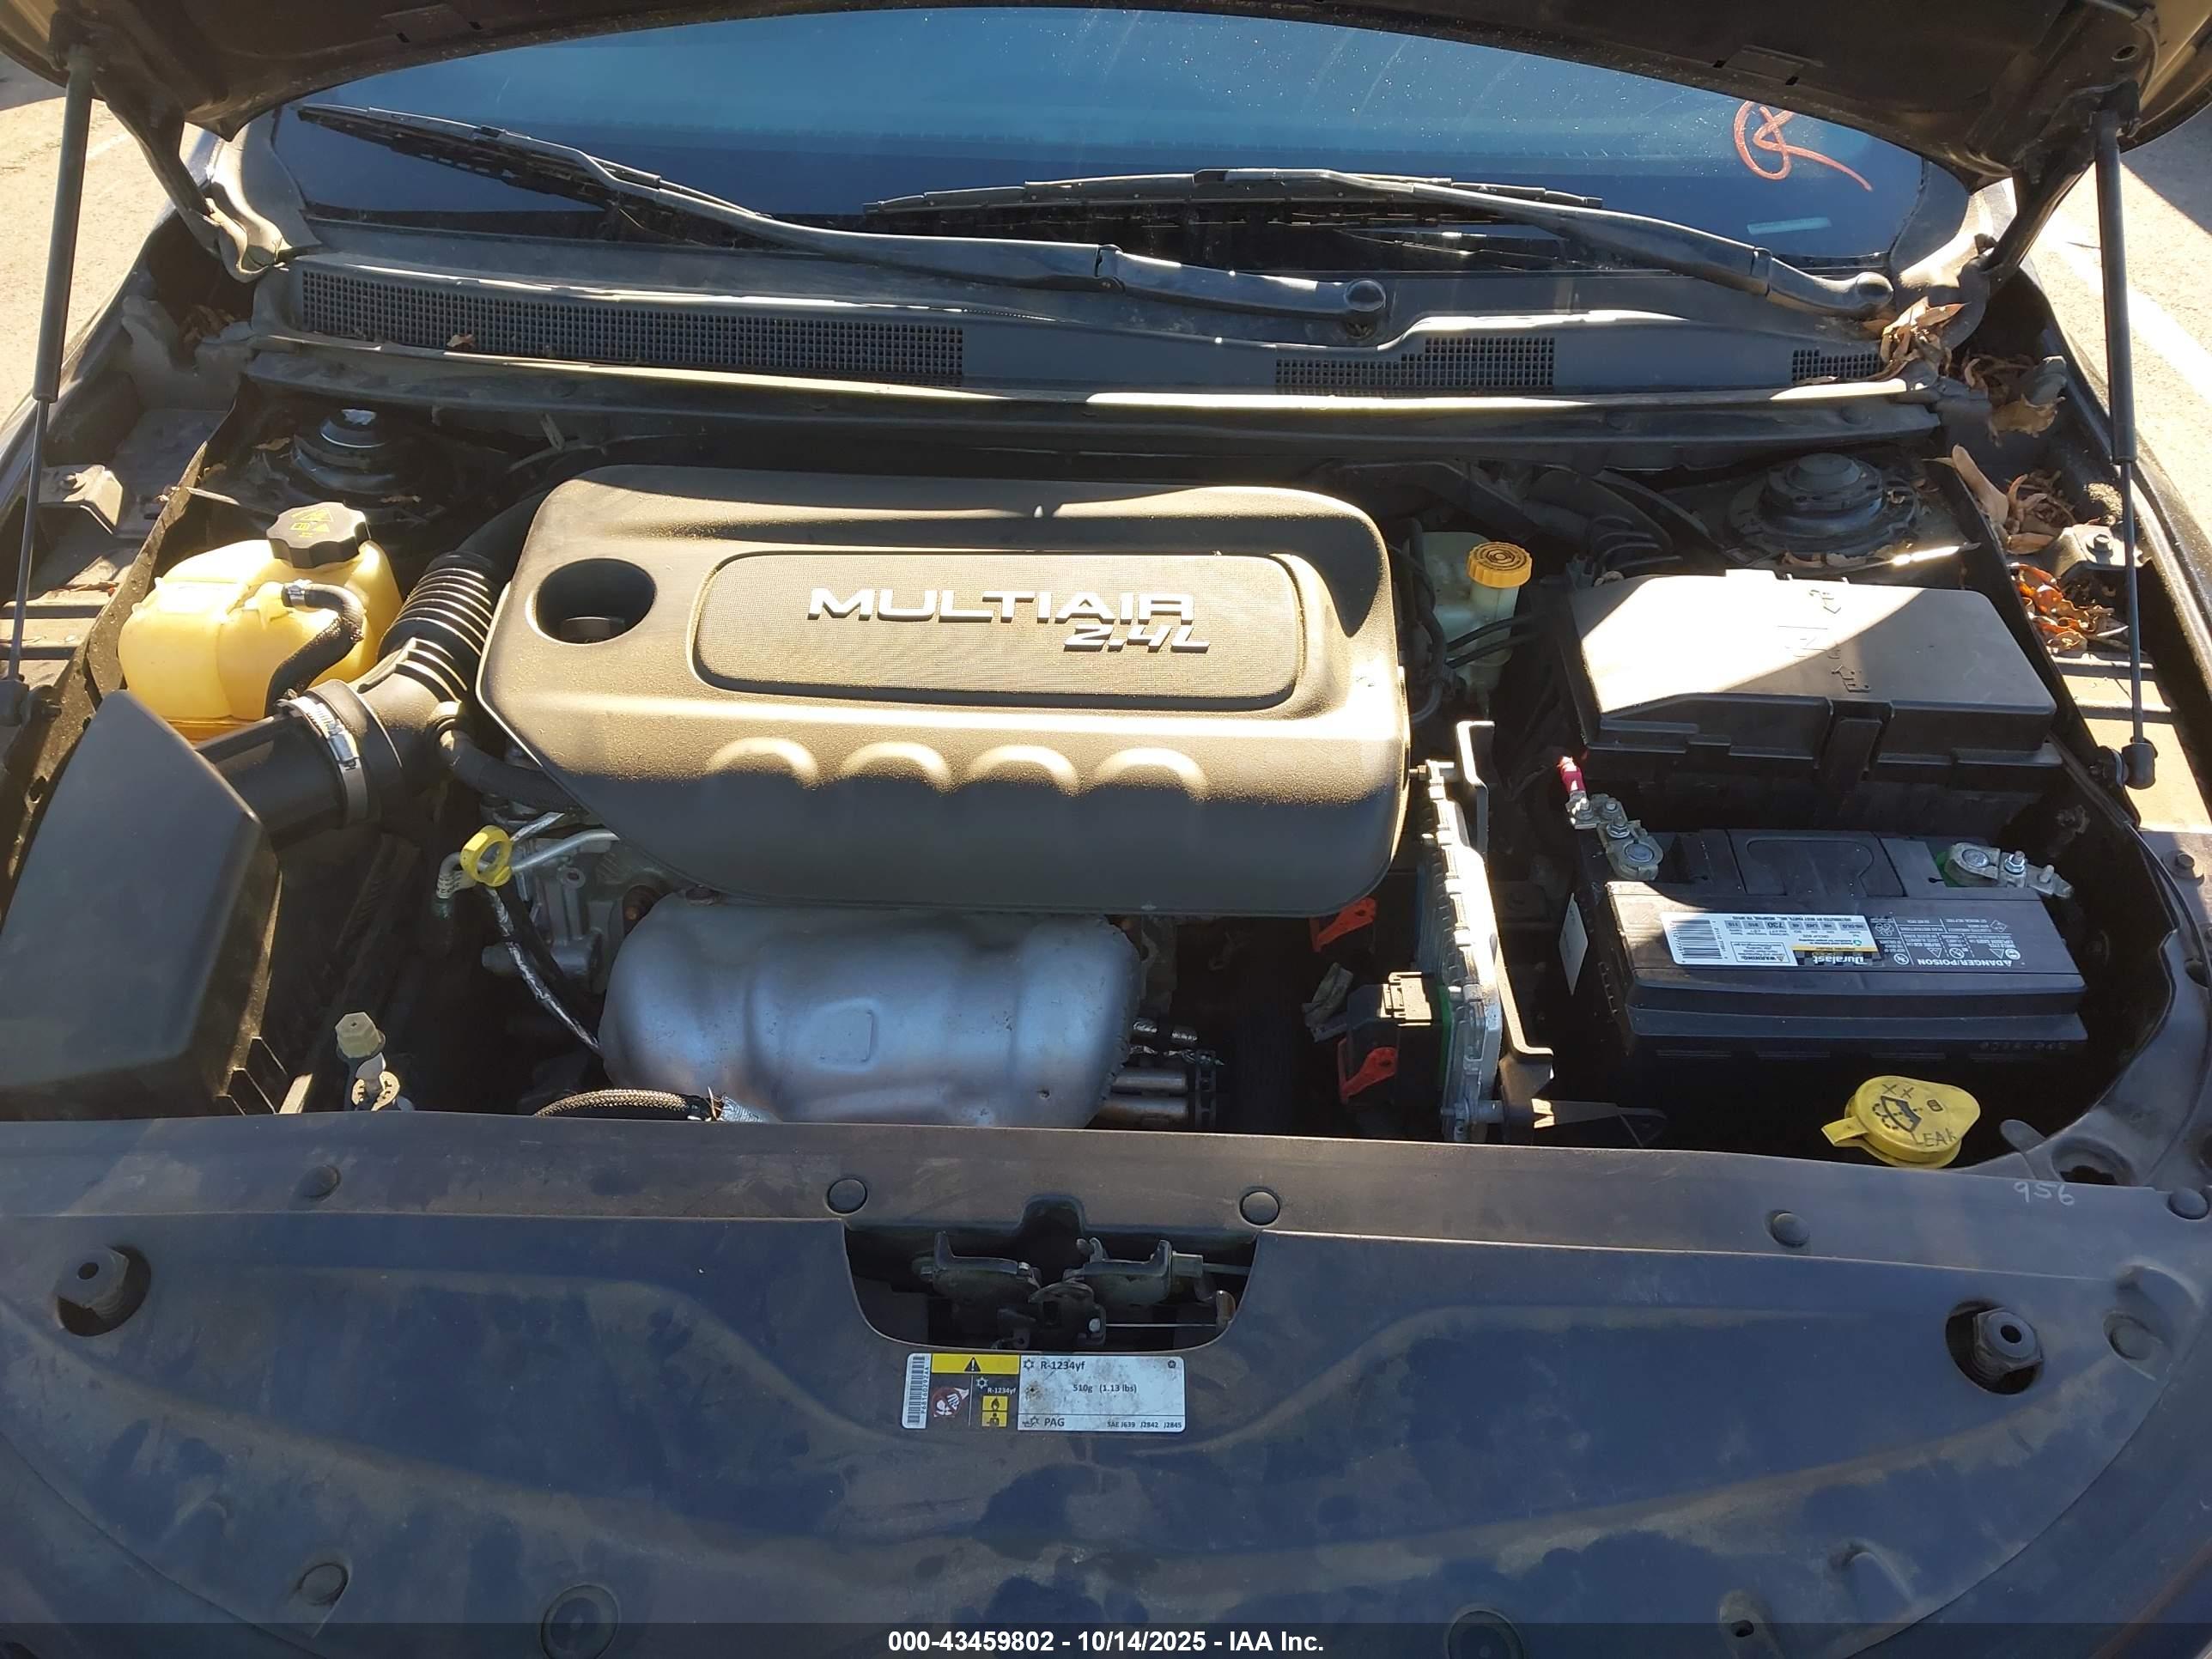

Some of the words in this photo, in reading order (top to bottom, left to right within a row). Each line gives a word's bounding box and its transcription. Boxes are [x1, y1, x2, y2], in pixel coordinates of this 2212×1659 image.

[808, 586, 1194, 624] MULTIAIR
[1063, 624, 1210, 653] 2.4L
[1813, 956, 1868, 965] Duralast
[2013, 1180, 2075, 1206] 956
[1040, 1360, 1085, 1372] R-1234yf
[988, 1387, 1017, 1395] R-1234yf
[1073, 1383, 1093, 1394] 510g
[1099, 1383, 1120, 1393] (1.13
[1121, 1383, 1137, 1393] lbs)
[1044, 1418, 1065, 1427] PAG
